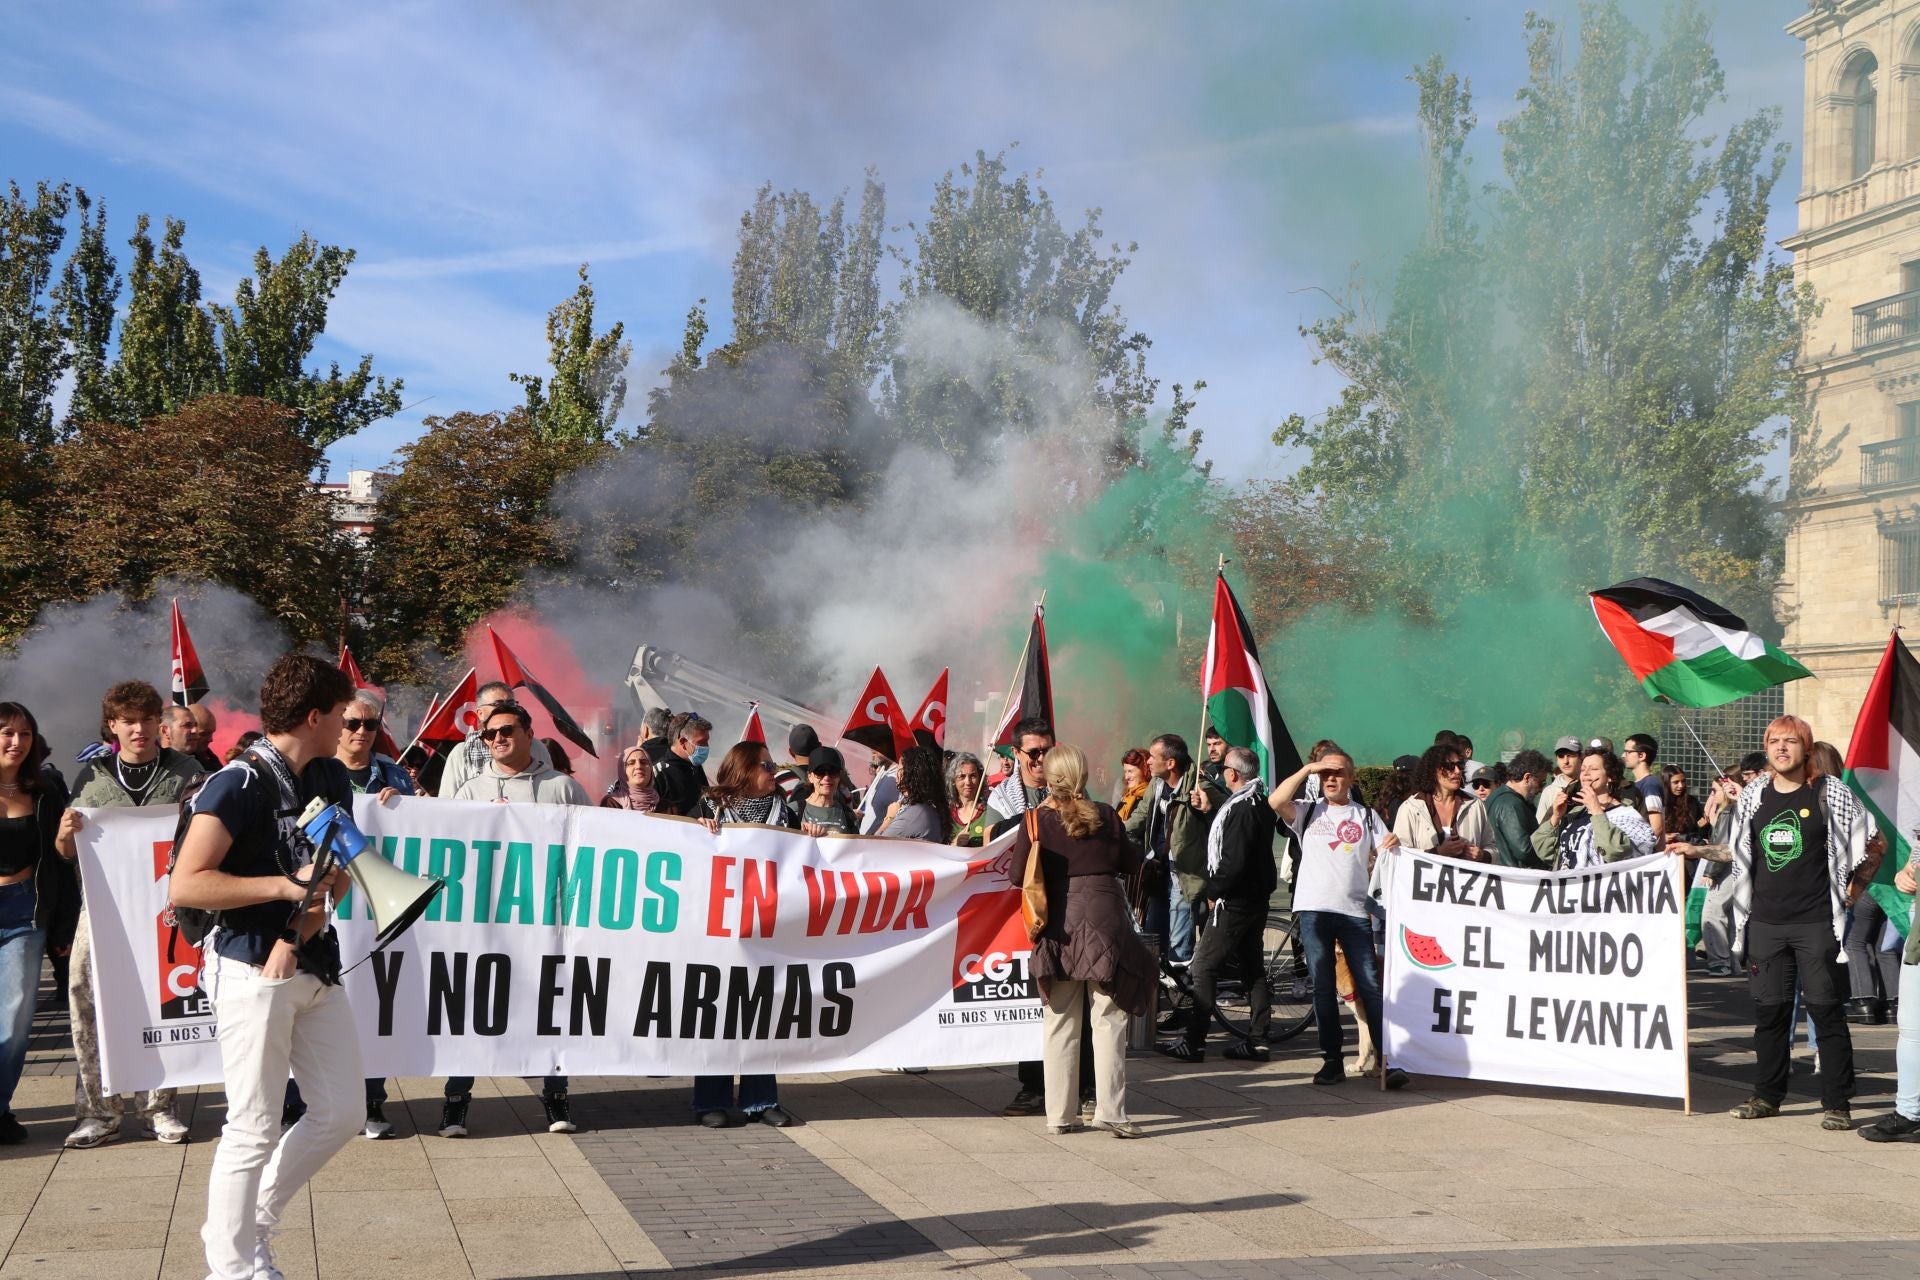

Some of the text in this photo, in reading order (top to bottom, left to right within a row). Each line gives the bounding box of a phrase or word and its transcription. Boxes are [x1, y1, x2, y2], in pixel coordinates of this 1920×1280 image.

[335, 835, 936, 939] IRTAMOS EN VIDA
[1412, 859, 1679, 915] GAZA AGUANTA
[959, 950, 1033, 983] CGT
[1463, 925, 1644, 978] EL MUNDO
[183, 998, 211, 1015] LE
[370, 950, 857, 1040] Y NO EN ARMAS
[972, 979, 1028, 1000] LEÓN
[142, 1030, 162, 1044] NO
[170, 1026, 201, 1042] NOS
[938, 1007, 1045, 1025] NO NOS VENDEM
[1431, 987, 1674, 1051] SE LEVANTA
